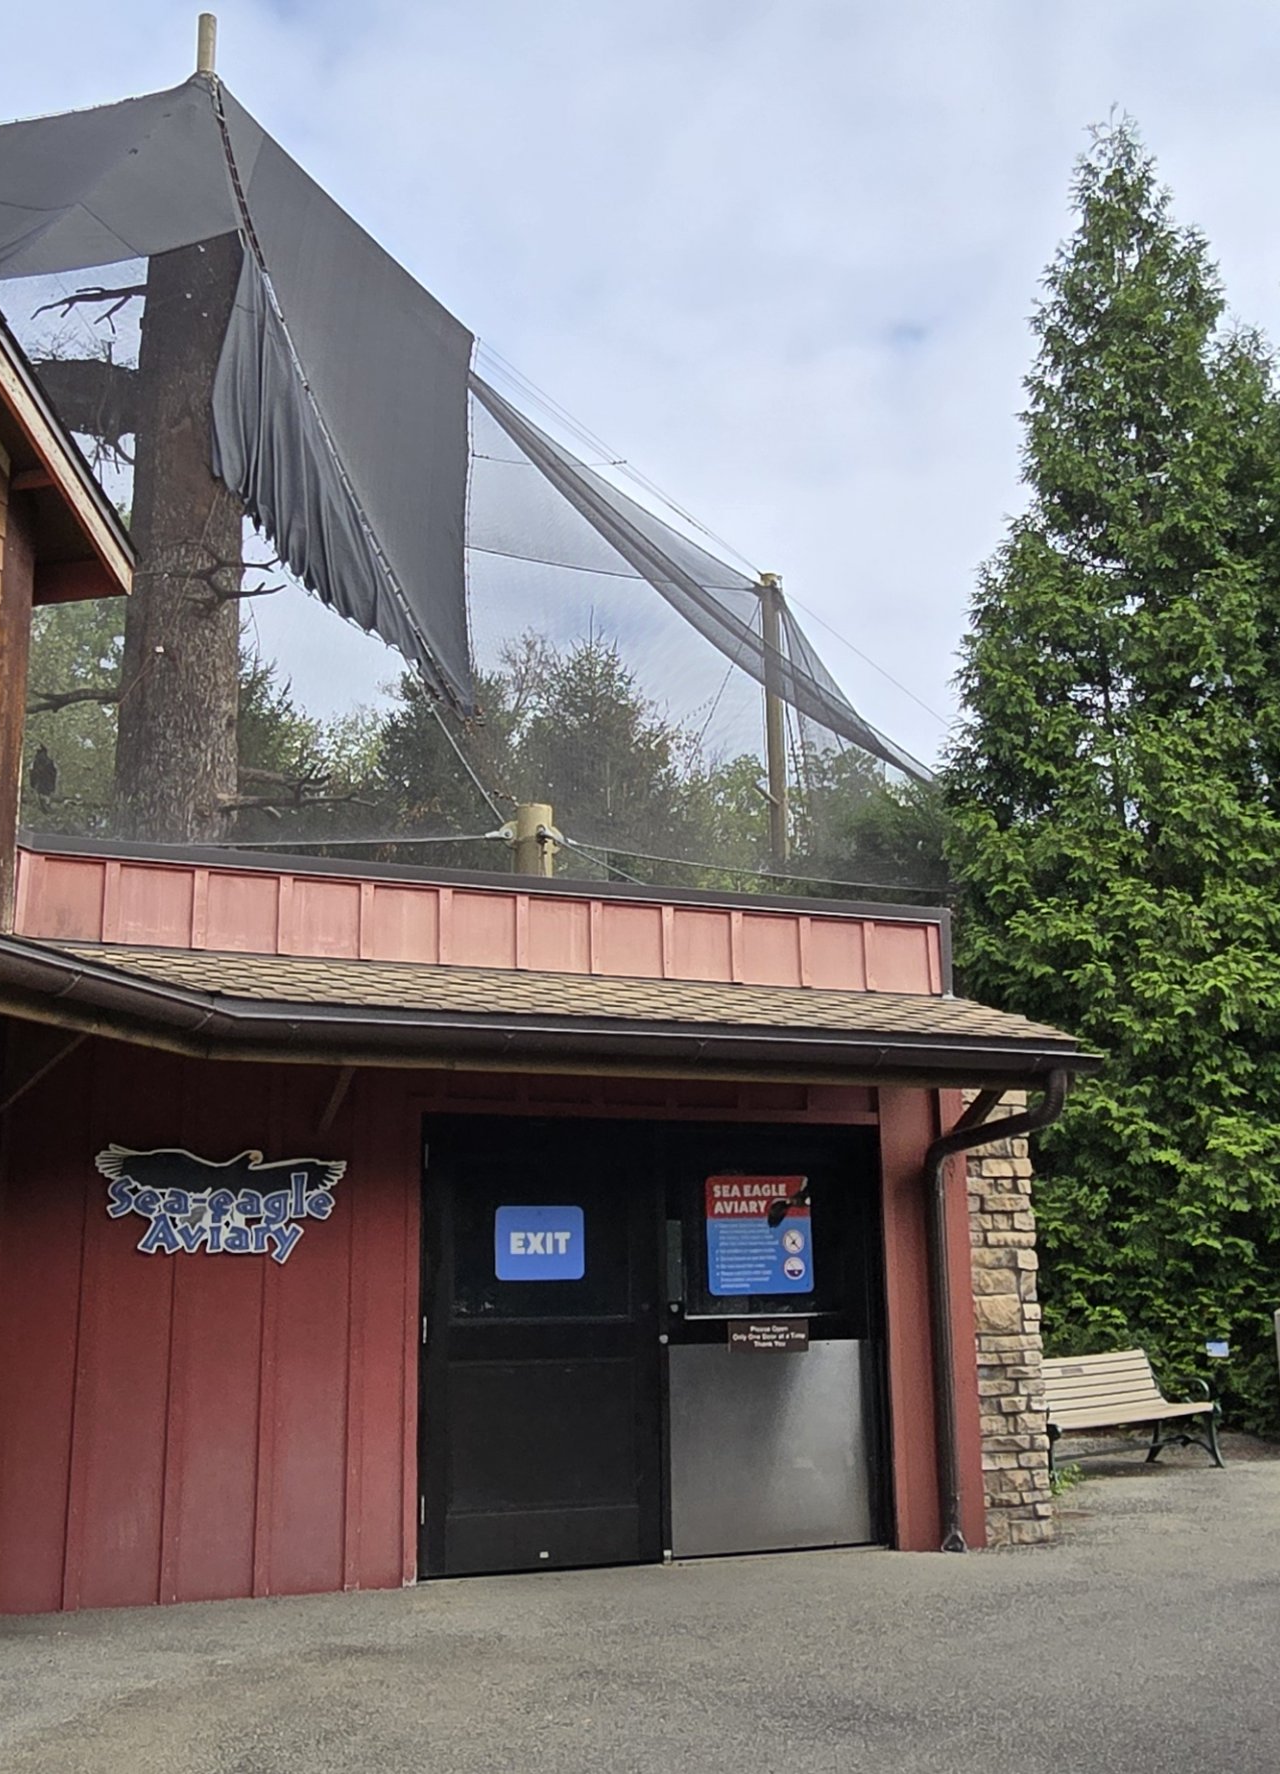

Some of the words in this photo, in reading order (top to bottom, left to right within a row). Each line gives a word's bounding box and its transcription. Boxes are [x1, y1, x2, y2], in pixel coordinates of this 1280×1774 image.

[713, 1184, 741, 1198] SEA
[743, 1183, 787, 1197] EAGLE
[107, 1173, 335, 1224] Sea-eagle
[714, 1200, 767, 1215] AVIARY
[138, 1214, 303, 1263] Aviary
[510, 1232, 571, 1255] EXIT
[771, 1324, 789, 1332] Open
[732, 1333, 747, 1342] Only
[748, 1333, 761, 1341] One
[791, 1331, 806, 1339] Time
[754, 1340, 773, 1348] Thank
